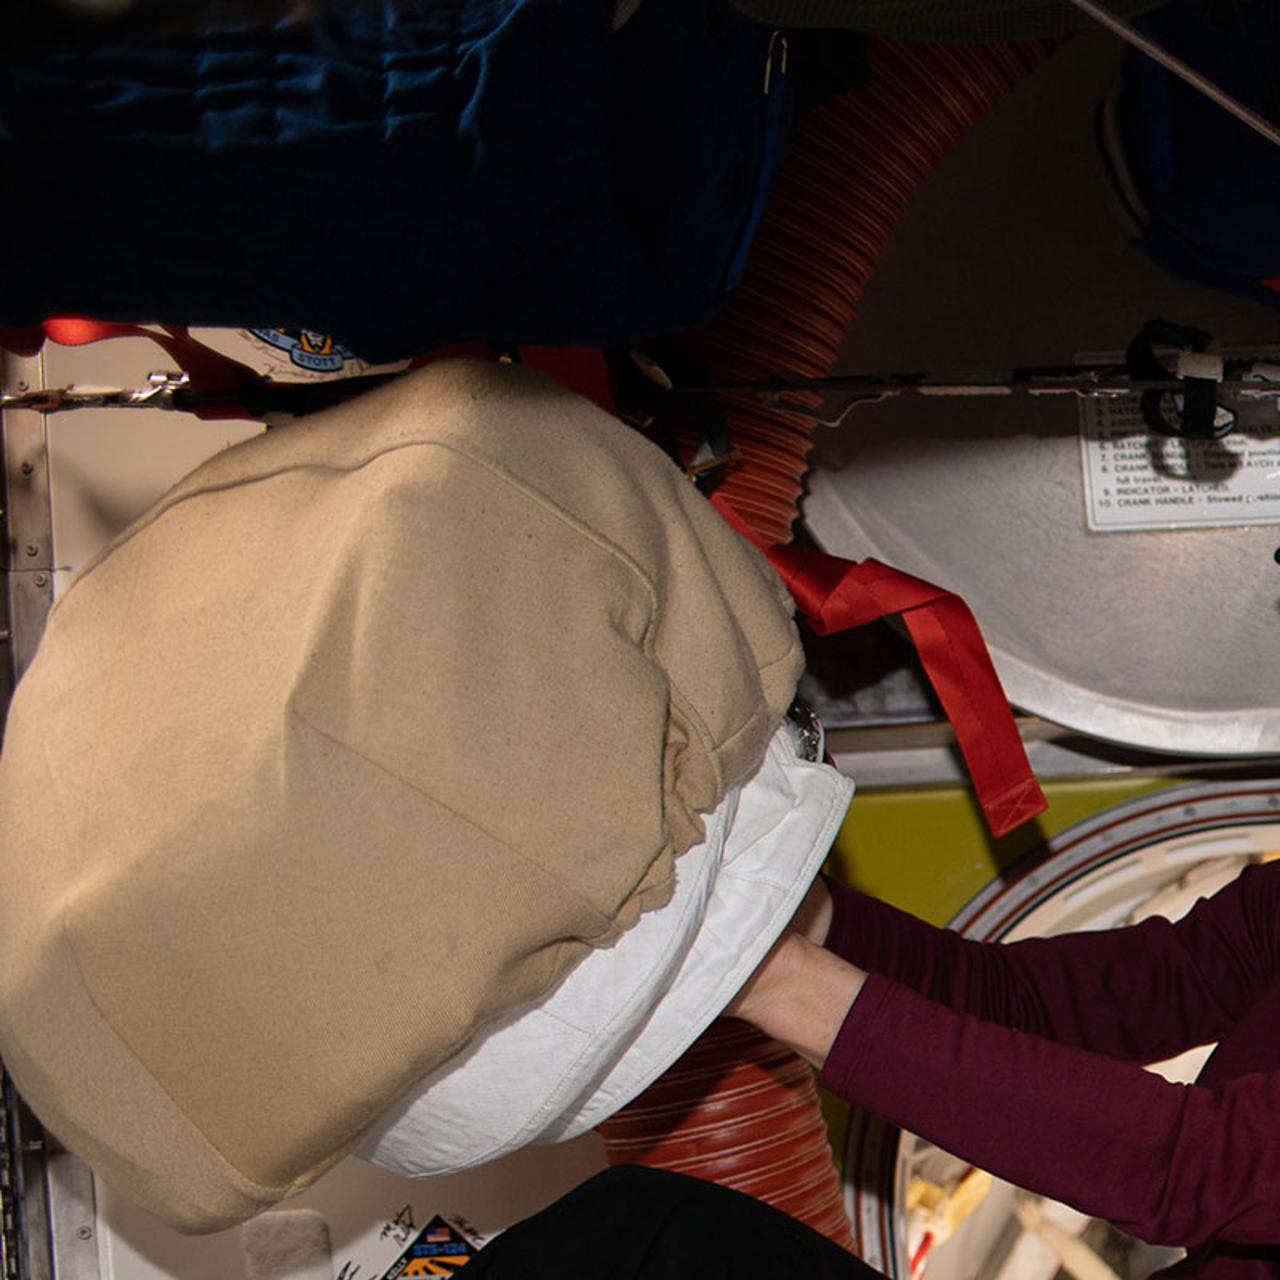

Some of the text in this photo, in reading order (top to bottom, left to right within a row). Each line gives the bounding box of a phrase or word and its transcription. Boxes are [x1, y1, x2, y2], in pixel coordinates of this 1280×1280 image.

[296, 353, 337, 368] STOTT
[1117, 487, 1170, 495] INDICATOR
[1118, 498, 1153, 507] CRANK
[1155, 497, 1194, 505] HANDLE
[1207, 495, 1242, 503] Stowed
